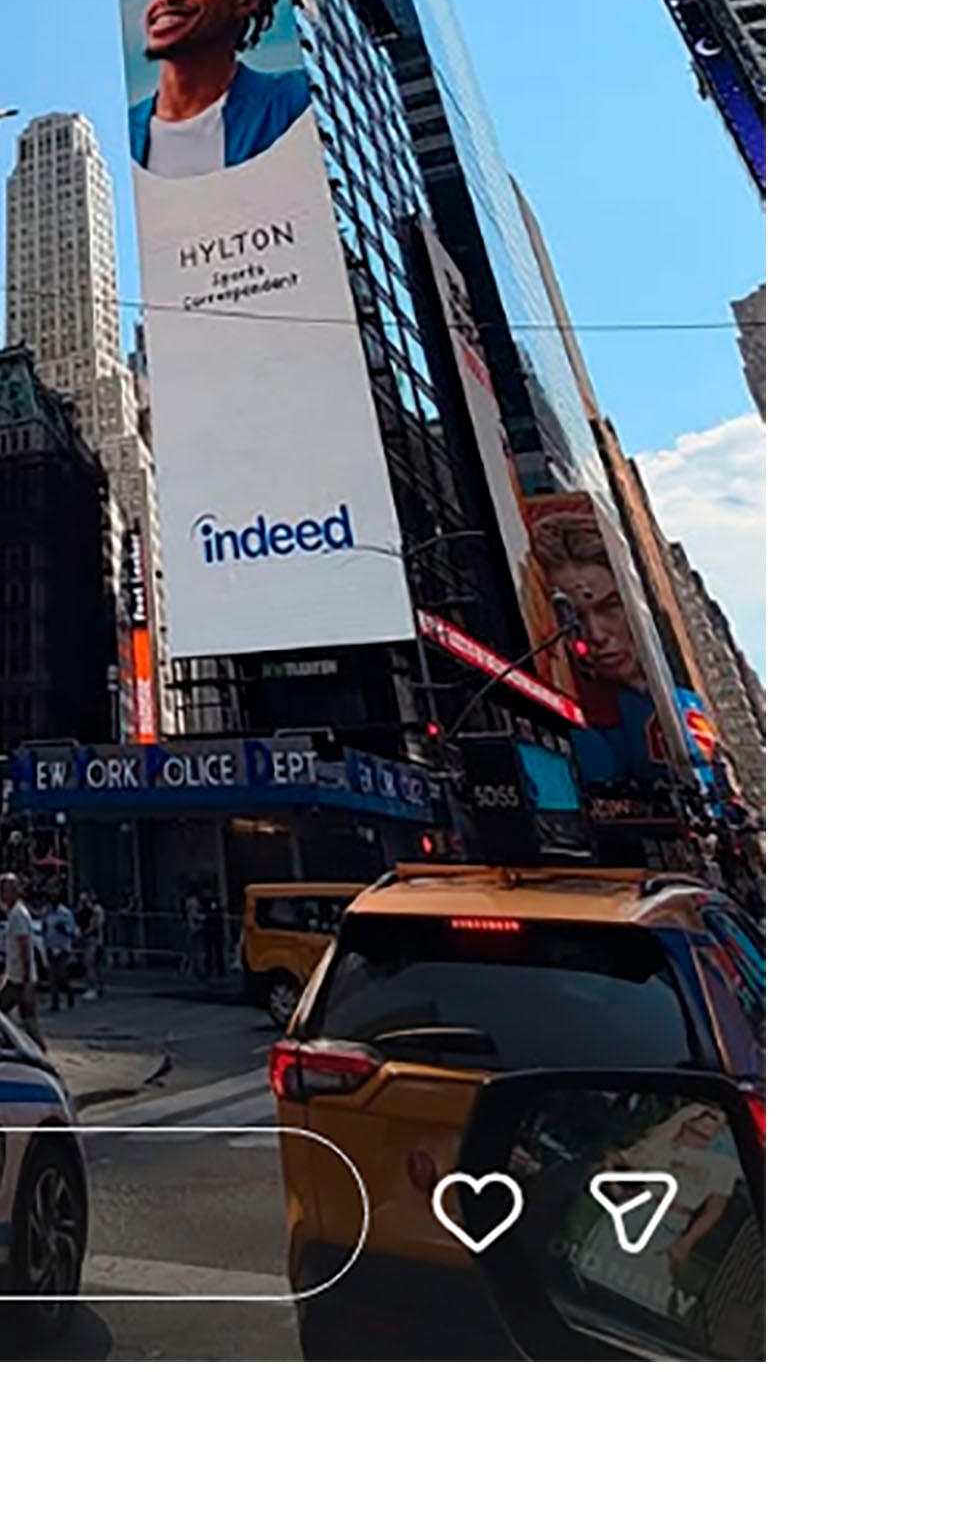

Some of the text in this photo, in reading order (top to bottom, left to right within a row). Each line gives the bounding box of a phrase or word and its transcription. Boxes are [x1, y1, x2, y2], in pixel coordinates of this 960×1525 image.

[179, 221, 295, 268] HYLTON
[183, 271, 299, 311] Correspondent
[212, 263, 265, 287] Sports
[193, 503, 355, 566] indeed
[246, 741, 321, 788] DEPT
